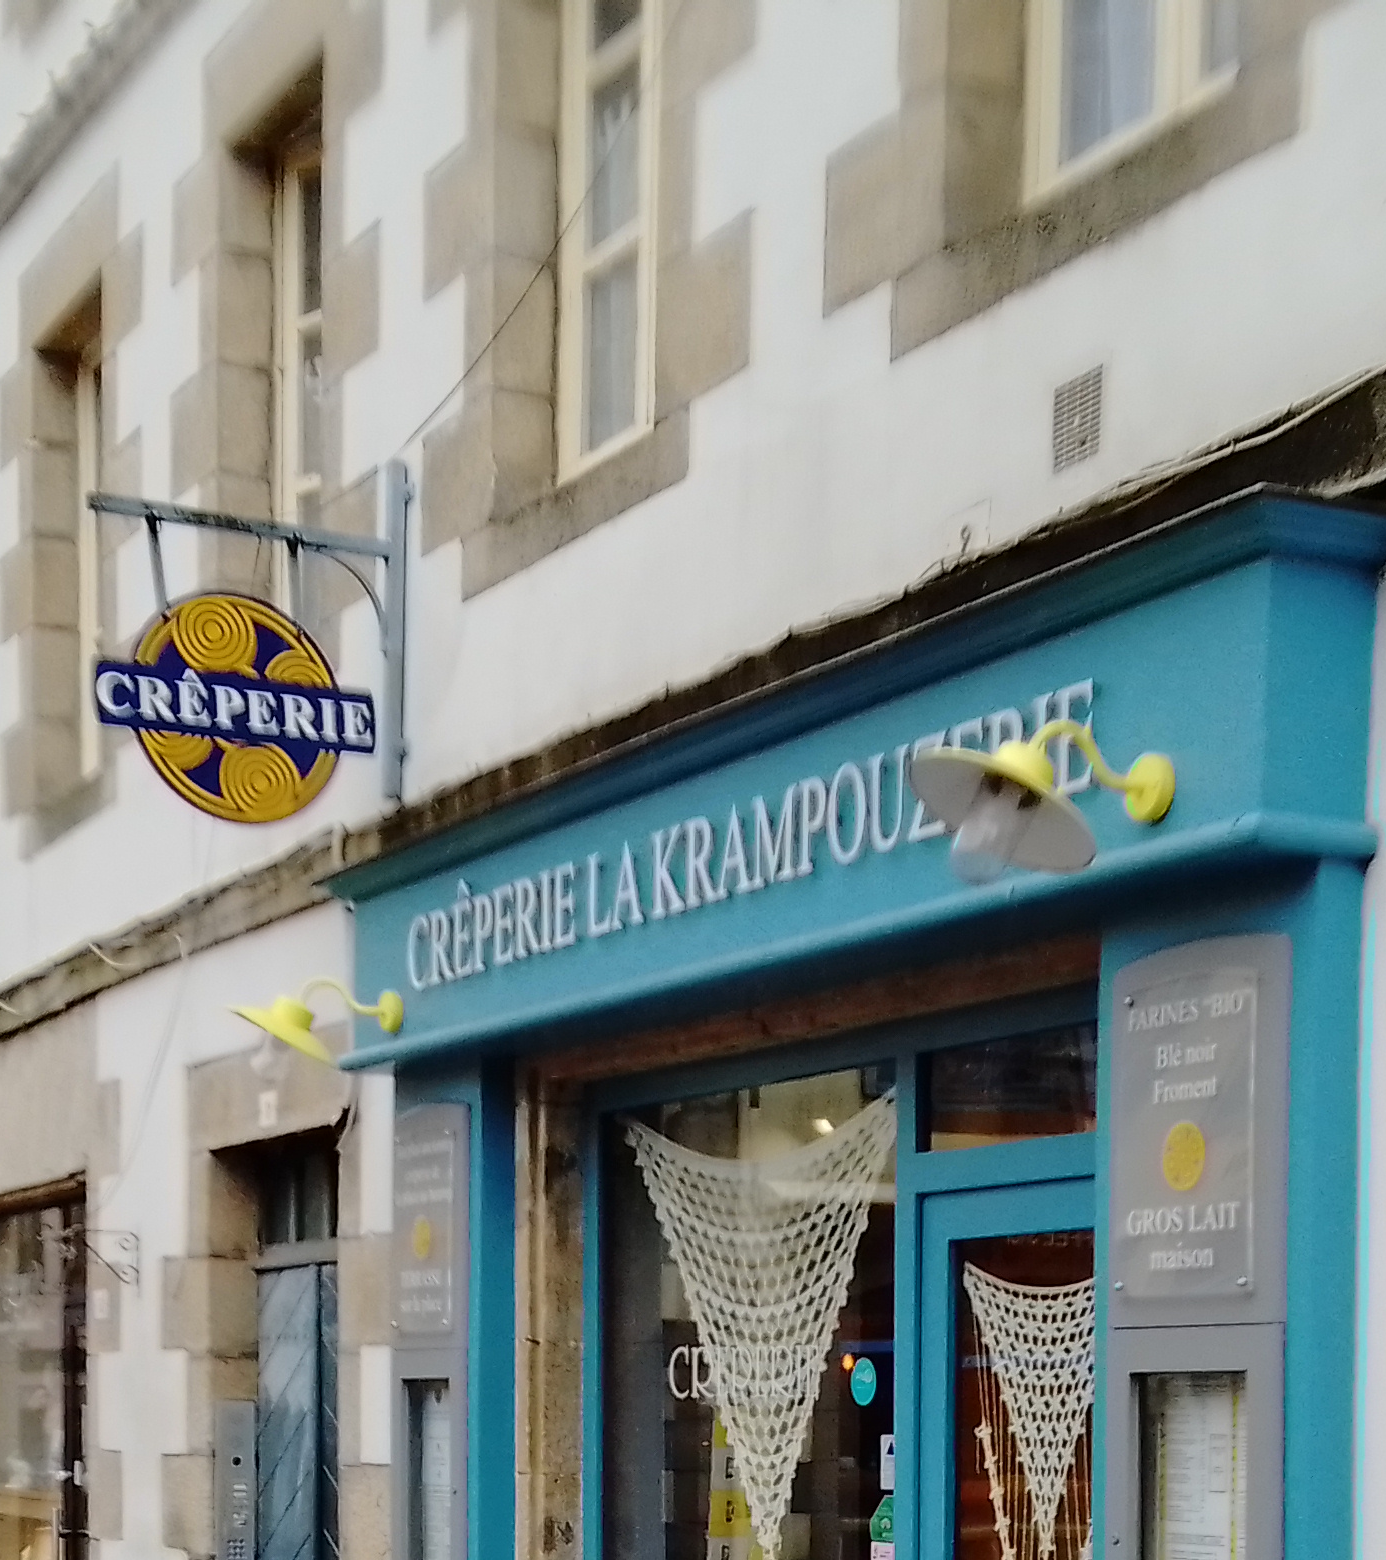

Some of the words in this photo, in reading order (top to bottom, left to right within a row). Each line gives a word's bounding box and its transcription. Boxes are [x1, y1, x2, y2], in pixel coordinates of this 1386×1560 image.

[94, 670, 375, 748] CRÊPERIE
[407, 879, 578, 992] CRÊPERIE
[586, 841, 645, 938] LA
[1127, 1206, 1184, 1234] GROS
[1188, 1202, 1241, 1232] LAIT
[1149, 1242, 1214, 1269] maison
